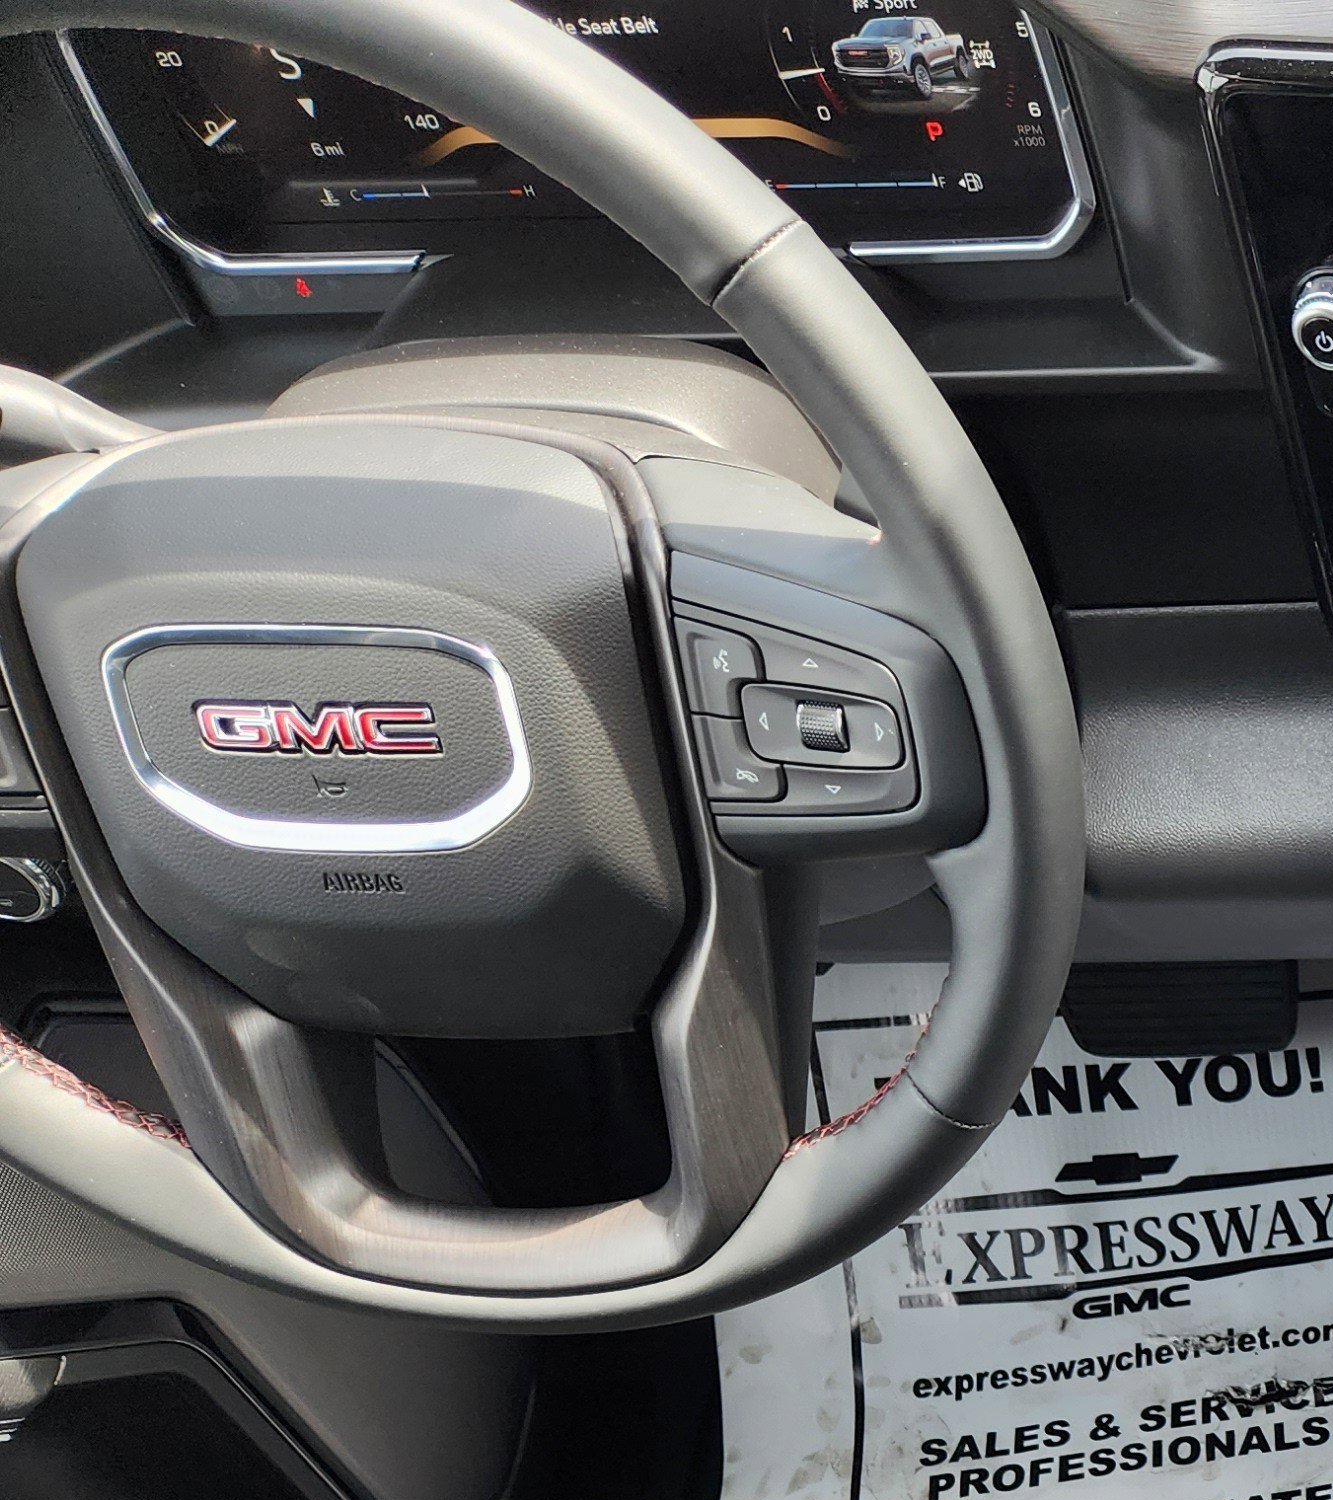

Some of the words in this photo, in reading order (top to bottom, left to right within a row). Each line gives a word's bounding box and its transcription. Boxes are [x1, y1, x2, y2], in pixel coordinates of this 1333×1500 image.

[874, 0, 918, 14] Sport
[577, 17, 620, 36] Seat
[623, 16, 659, 35] Belt
[1014, 21, 1029, 38] 5
[154, 51, 183, 68] 20
[970, 49, 994, 60] 2WD
[816, 105, 832, 122] 0
[1027, 102, 1042, 118] 6
[403, 113, 440, 131] 140
[1017, 125, 1044, 135] RPM
[925, 121, 943, 142] P
[310, 142, 324, 158] 6
[325, 142, 346, 158] mi
[1013, 136, 1046, 148] x1000
[523, 185, 536, 198] H
[197, 700, 443, 756] GMC
[322, 872, 405, 896] AIRBAG
[1155, 1047, 1325, 1107] YOU!
[1072, 1283, 1192, 1320] GMC
[919, 1419, 1071, 1468] SALES
[1089, 1412, 1122, 1441] &
